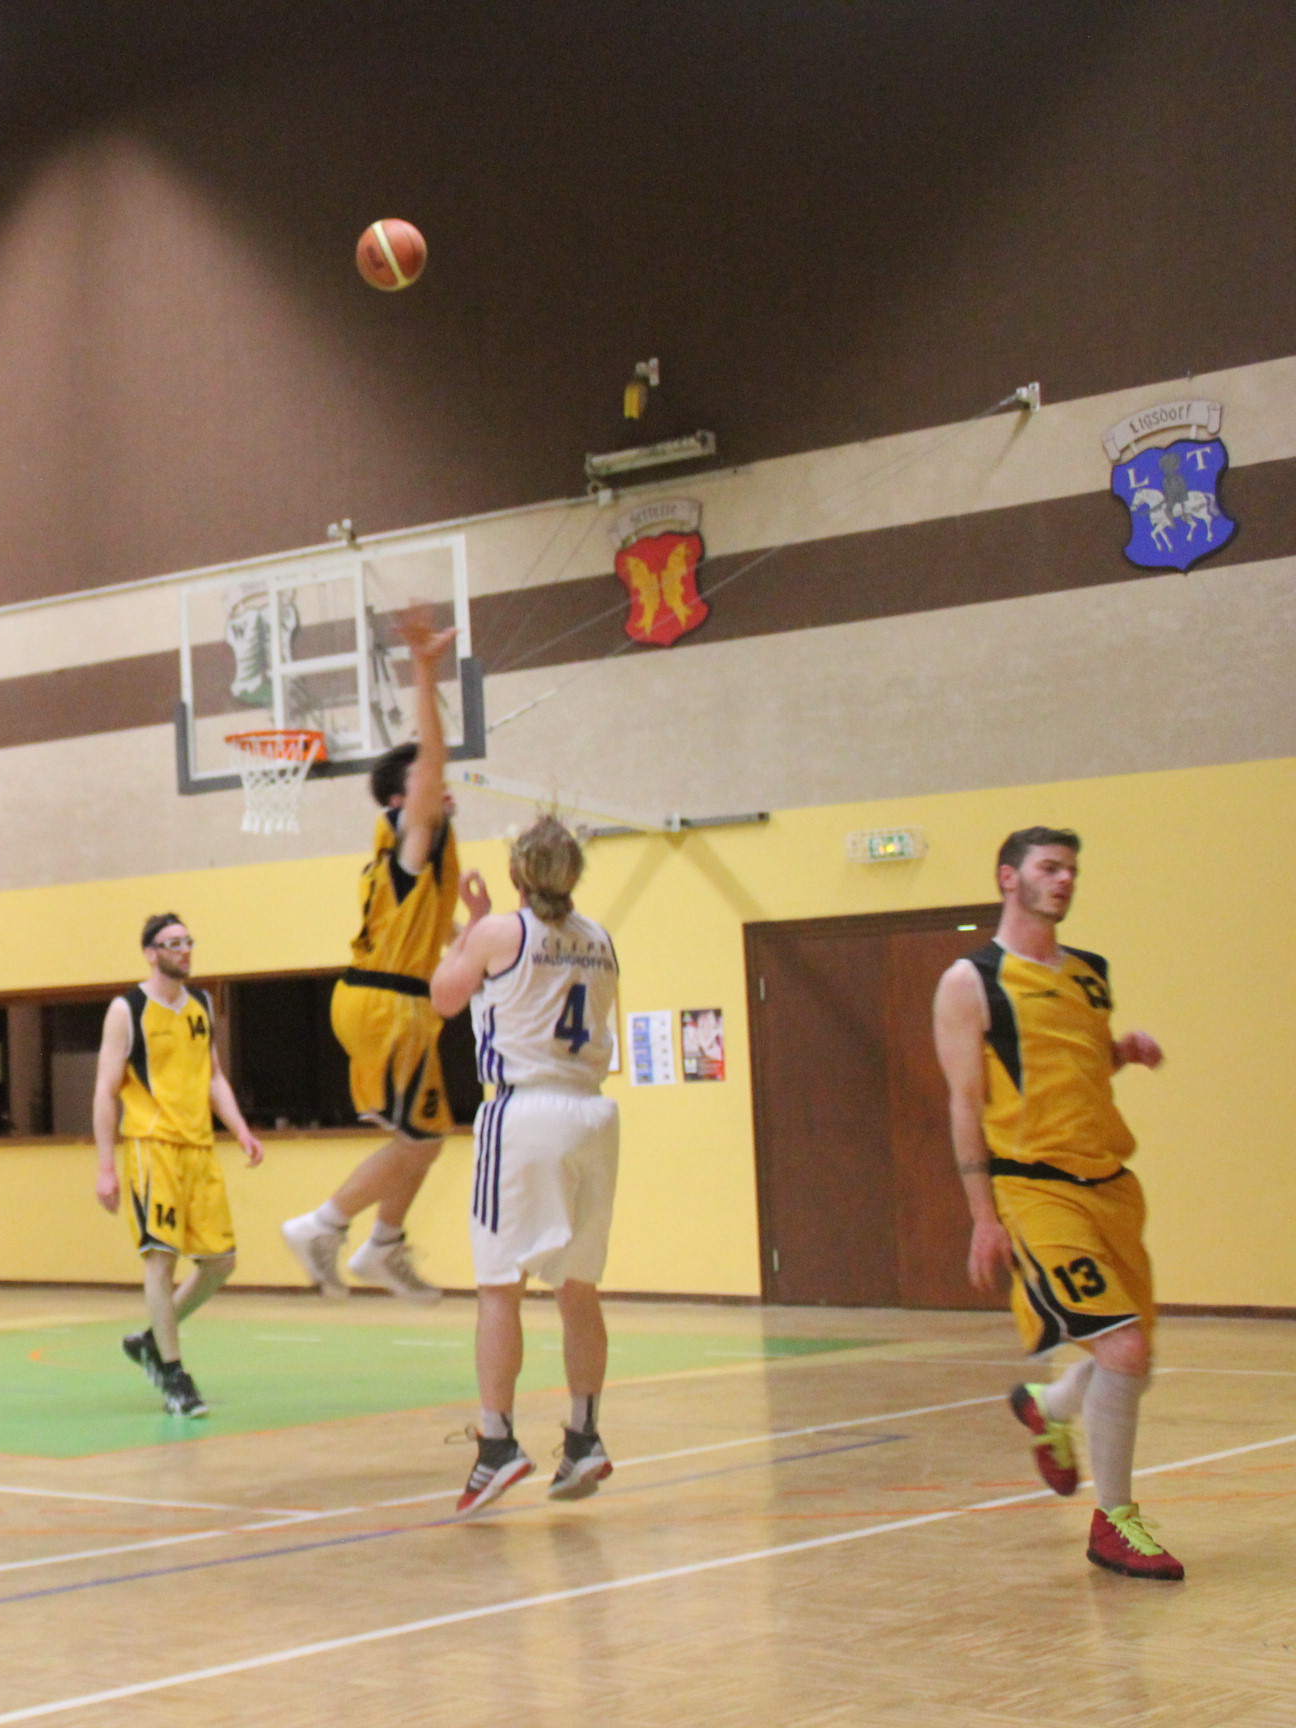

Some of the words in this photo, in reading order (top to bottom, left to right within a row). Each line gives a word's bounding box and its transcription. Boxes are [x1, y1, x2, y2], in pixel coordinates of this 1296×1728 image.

[1127, 468, 1149, 489] L
[1186, 446, 1212, 471] T
[187, 1014, 207, 1040] 14
[553, 983, 590, 1054] 4
[156, 1204, 176, 1231] 14
[1053, 1256, 1107, 1303] 13
